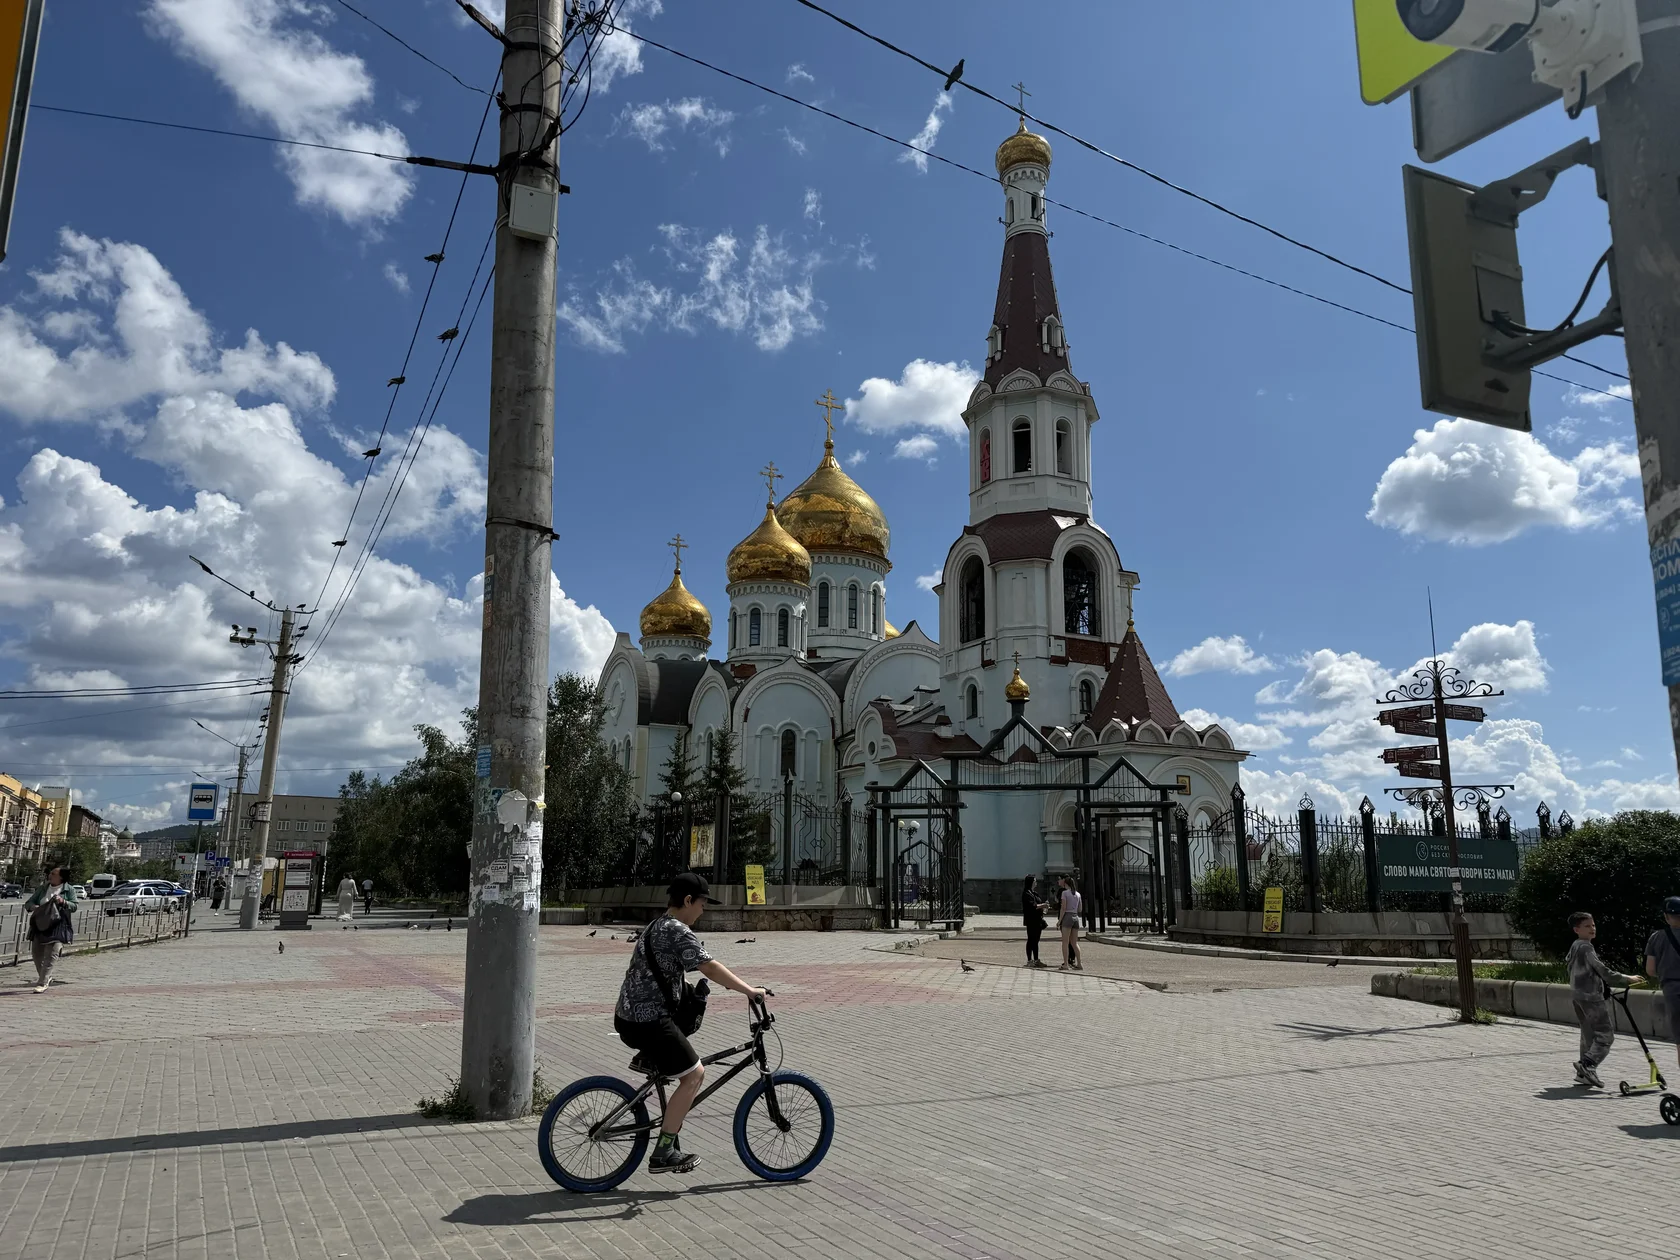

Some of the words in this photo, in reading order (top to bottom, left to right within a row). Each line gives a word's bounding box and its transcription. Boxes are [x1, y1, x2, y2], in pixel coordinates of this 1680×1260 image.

[1383, 865, 1407, 877] СЛОВО
[1408, 865, 1429, 878] МАМА
[1483, 868, 1496, 880] БЕЗ
[1496, 868, 1516, 881] МАТА!
